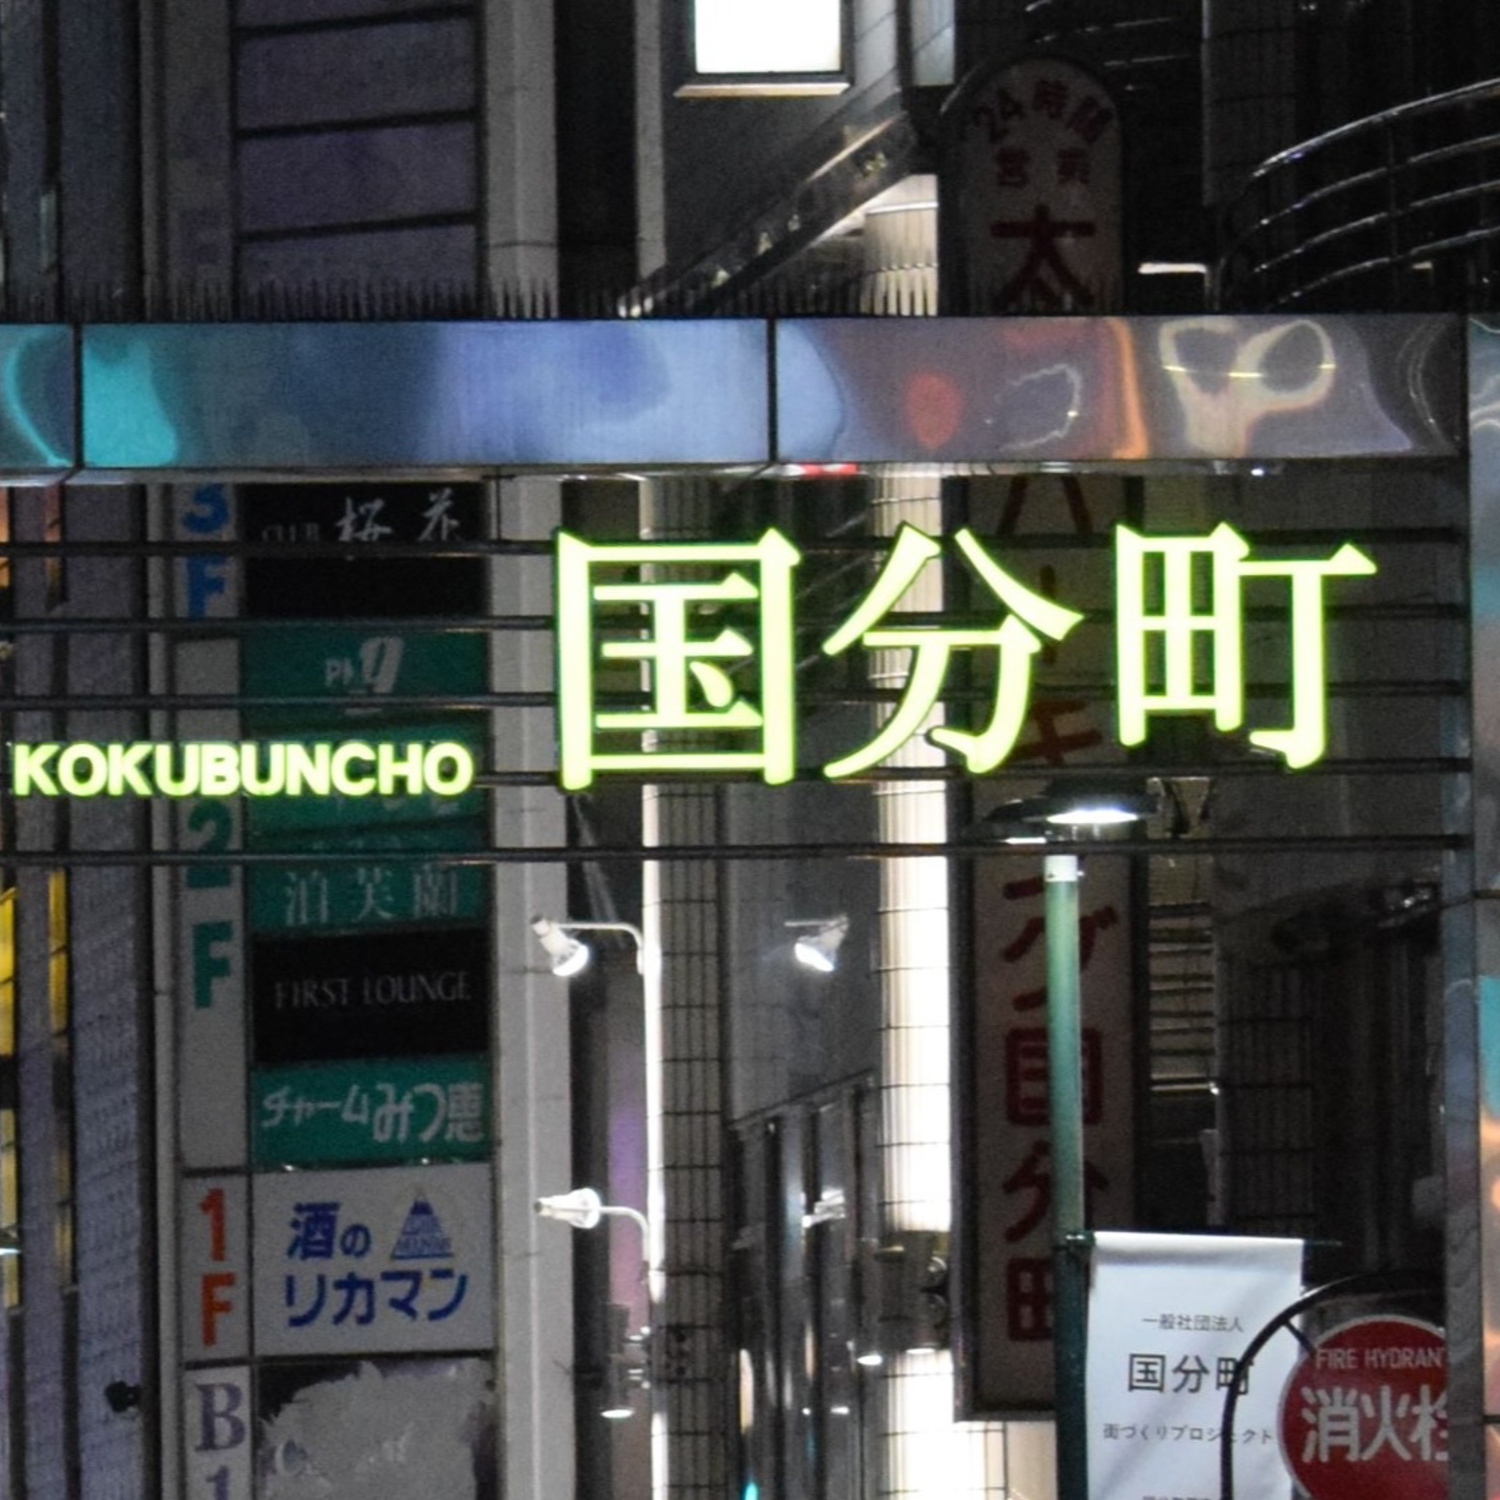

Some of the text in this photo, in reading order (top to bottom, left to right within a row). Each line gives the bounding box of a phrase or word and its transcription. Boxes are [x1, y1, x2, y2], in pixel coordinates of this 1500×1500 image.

[556, 523, 1377, 790] 国分町
[11, 740, 475, 797] KOKUBUNCHO
[275, 971, 472, 1010] FIRST LOUNGE
[287, 1202, 373, 1261] 酒の
[199, 1188, 236, 1347] 1F
[285, 1269, 469, 1328] リカマン
[1141, 1313, 1244, 1333] 一般社団法人
[1315, 1347, 1445, 1370] FIRE HYDRAN
